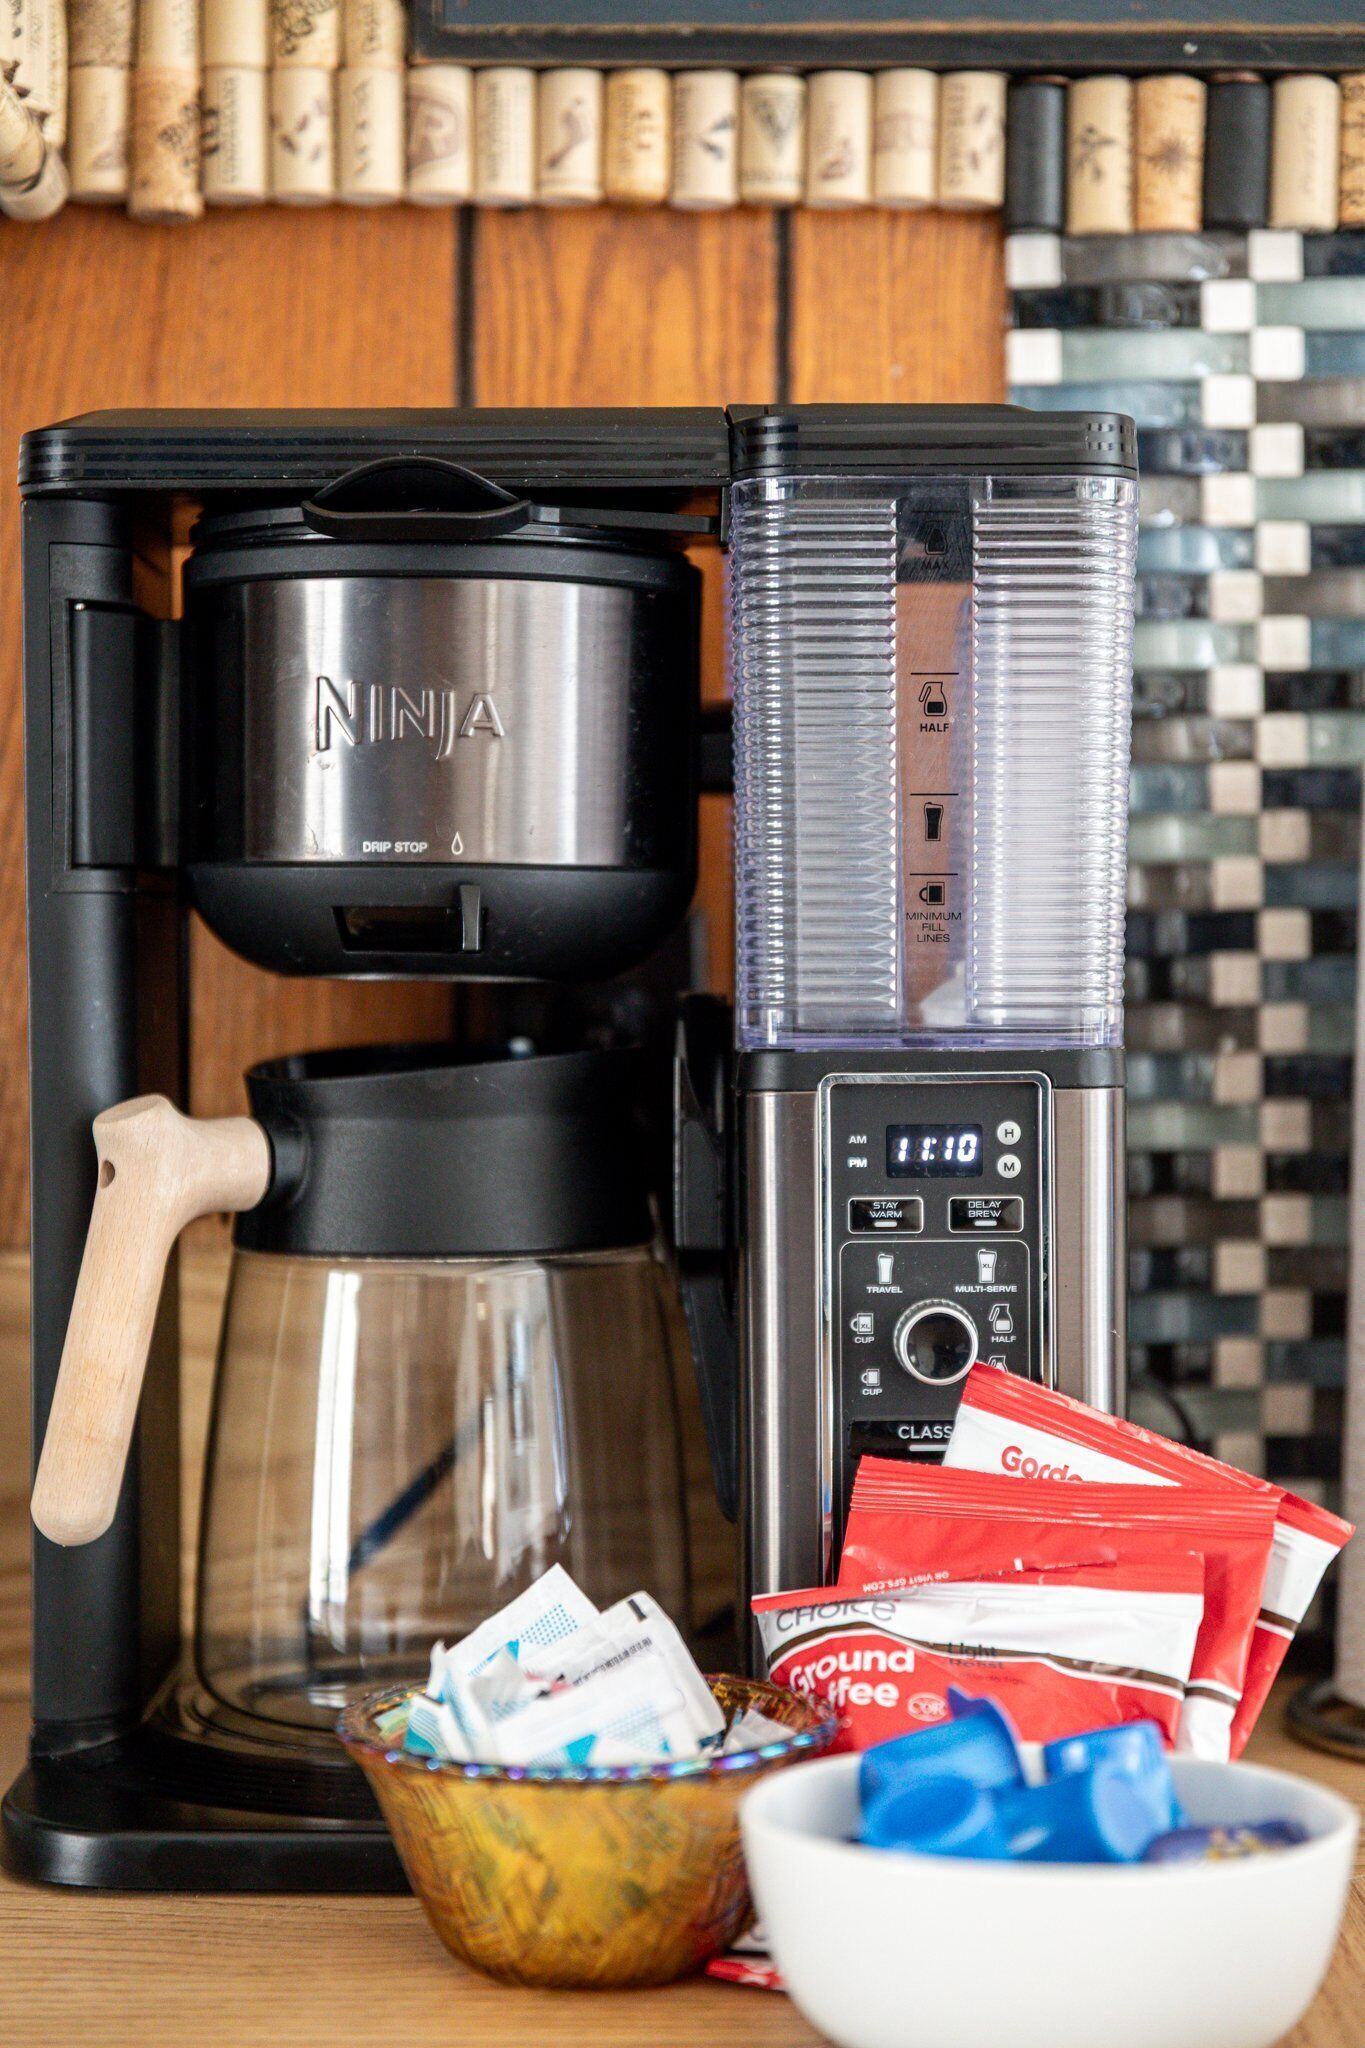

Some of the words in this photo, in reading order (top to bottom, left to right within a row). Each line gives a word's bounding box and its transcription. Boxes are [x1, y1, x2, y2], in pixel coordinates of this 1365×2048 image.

[920, 560, 951, 571] MAX
[315, 675, 505, 760] NINJA
[919, 722, 950, 733] HALF
[362, 840, 391, 853] DRIP
[394, 840, 428, 853] STOP
[905, 911, 962, 921] MINIMUM
[921, 922, 946, 932] FILL
[916, 933, 951, 943] LINES
[1004, 1129, 1014, 1138] H
[848, 1135, 867, 1144] AM
[897, 1133, 978, 1162] 11:10
[847, 1158, 868, 1168] PM
[1003, 1162, 1015, 1172] M
[873, 1201, 899, 1209] STAY
[968, 1201, 1002, 1209] DELAY
[869, 1210, 903, 1218] WARM
[968, 1210, 1002, 1218] BREW
[866, 1286, 903, 1294] TRAVEL
[955, 1285, 1018, 1293] MULTI-SERVE
[854, 1336, 875, 1344] CUP
[862, 1388, 883, 1396] CUP
[898, 1425, 954, 1440] CLASS
[1001, 1445, 1083, 1481] Gord
[789, 1648, 915, 1696] Ground
[828, 1676, 900, 1708] ffee
